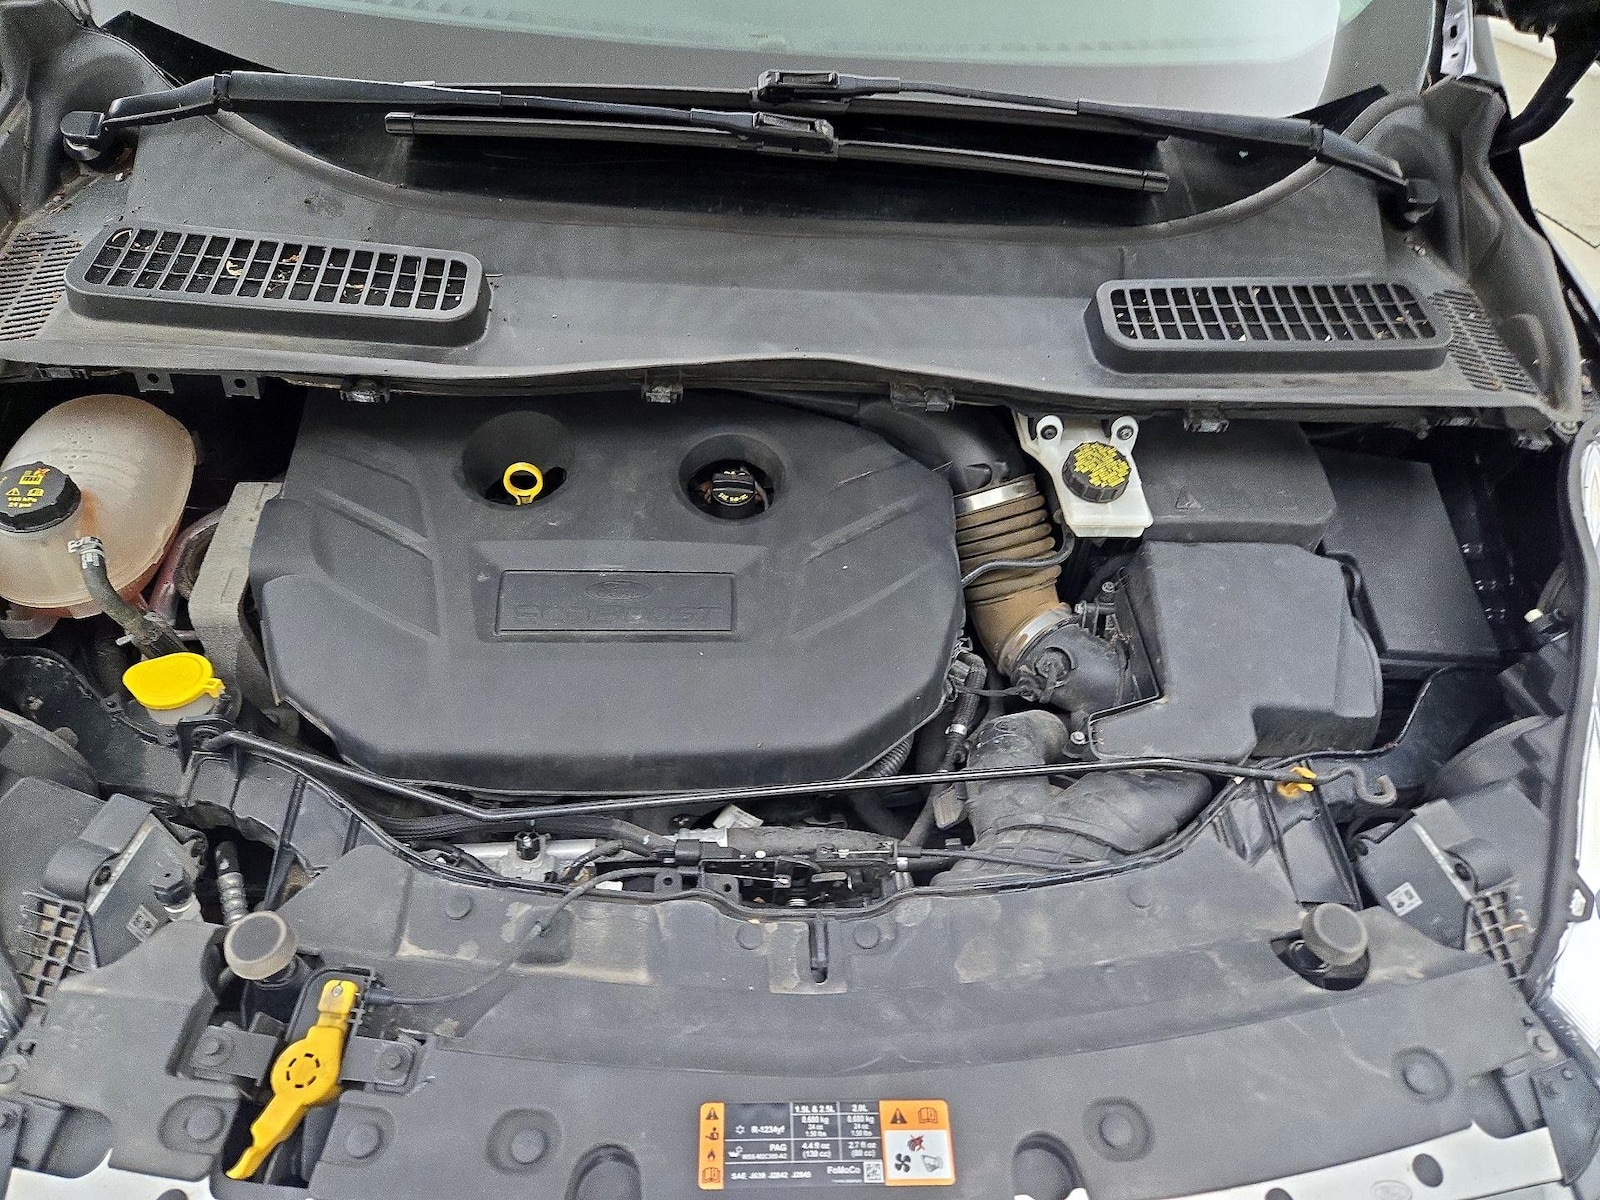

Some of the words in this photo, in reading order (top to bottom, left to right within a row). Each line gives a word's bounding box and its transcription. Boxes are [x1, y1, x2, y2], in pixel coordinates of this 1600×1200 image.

[820, 1115, 830, 1125] kg
[865, 1115, 876, 1125] kg
[750, 1125, 786, 1135] R-1234yf
[769, 1143, 788, 1152] PAG
[819, 1150, 832, 1159] cc)
[864, 1149, 876, 1158] cc)
[826, 1165, 861, 1174] FoMoCo
[730, 1172, 748, 1180] SAE
